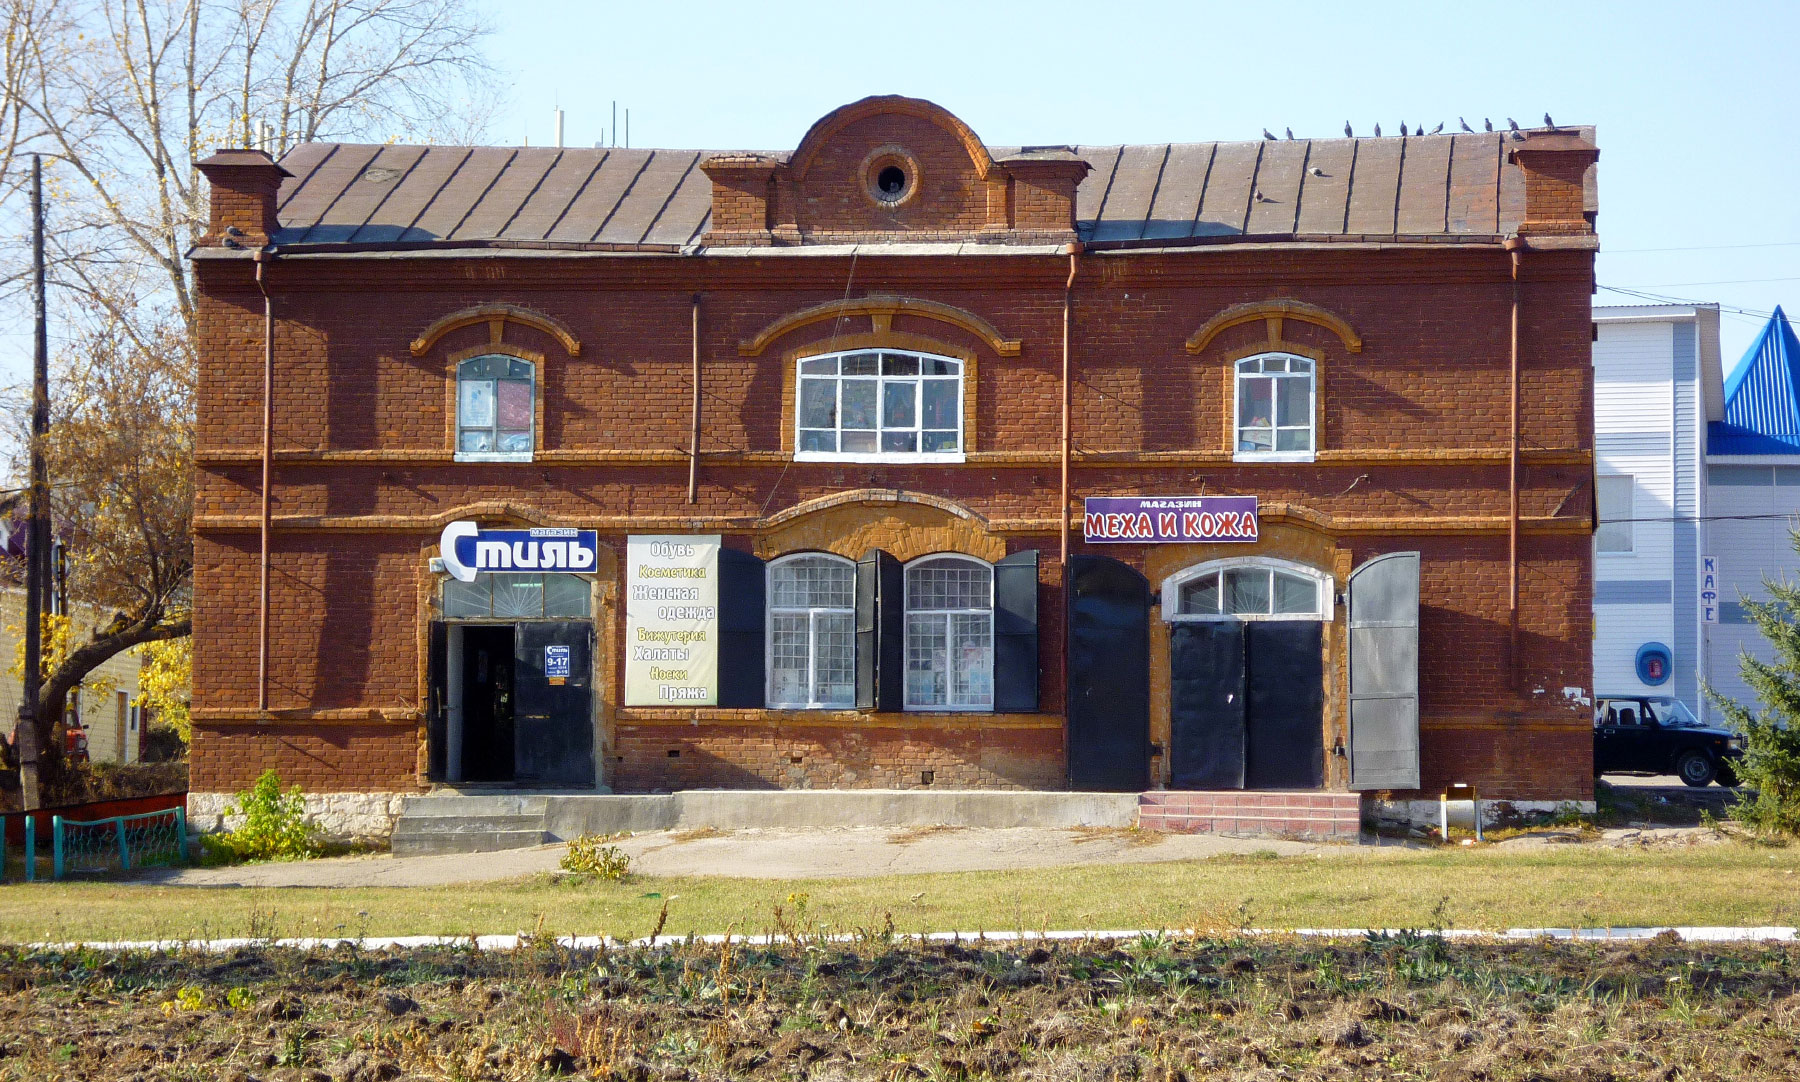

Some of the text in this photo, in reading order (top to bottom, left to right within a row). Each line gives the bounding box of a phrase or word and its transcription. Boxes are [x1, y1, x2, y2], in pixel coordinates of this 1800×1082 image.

[530, 528, 578, 537] магазин
[1084, 512, 1258, 538] МЕХА И КОЖА
[440, 521, 594, 582] Стиль
[650, 541, 695, 559] Обувь
[638, 564, 706, 579] Косметика
[632, 585, 699, 600] Женская
[1702, 558, 1716, 621] КАФЕ
[657, 606, 715, 620] одежда
[637, 628, 706, 645] Бижутерия
[633, 646, 689, 661] Халаты
[547, 657, 568, 666] 9-17
[650, 667, 688, 680] Носки
[658, 684, 707, 702] Пряжа
